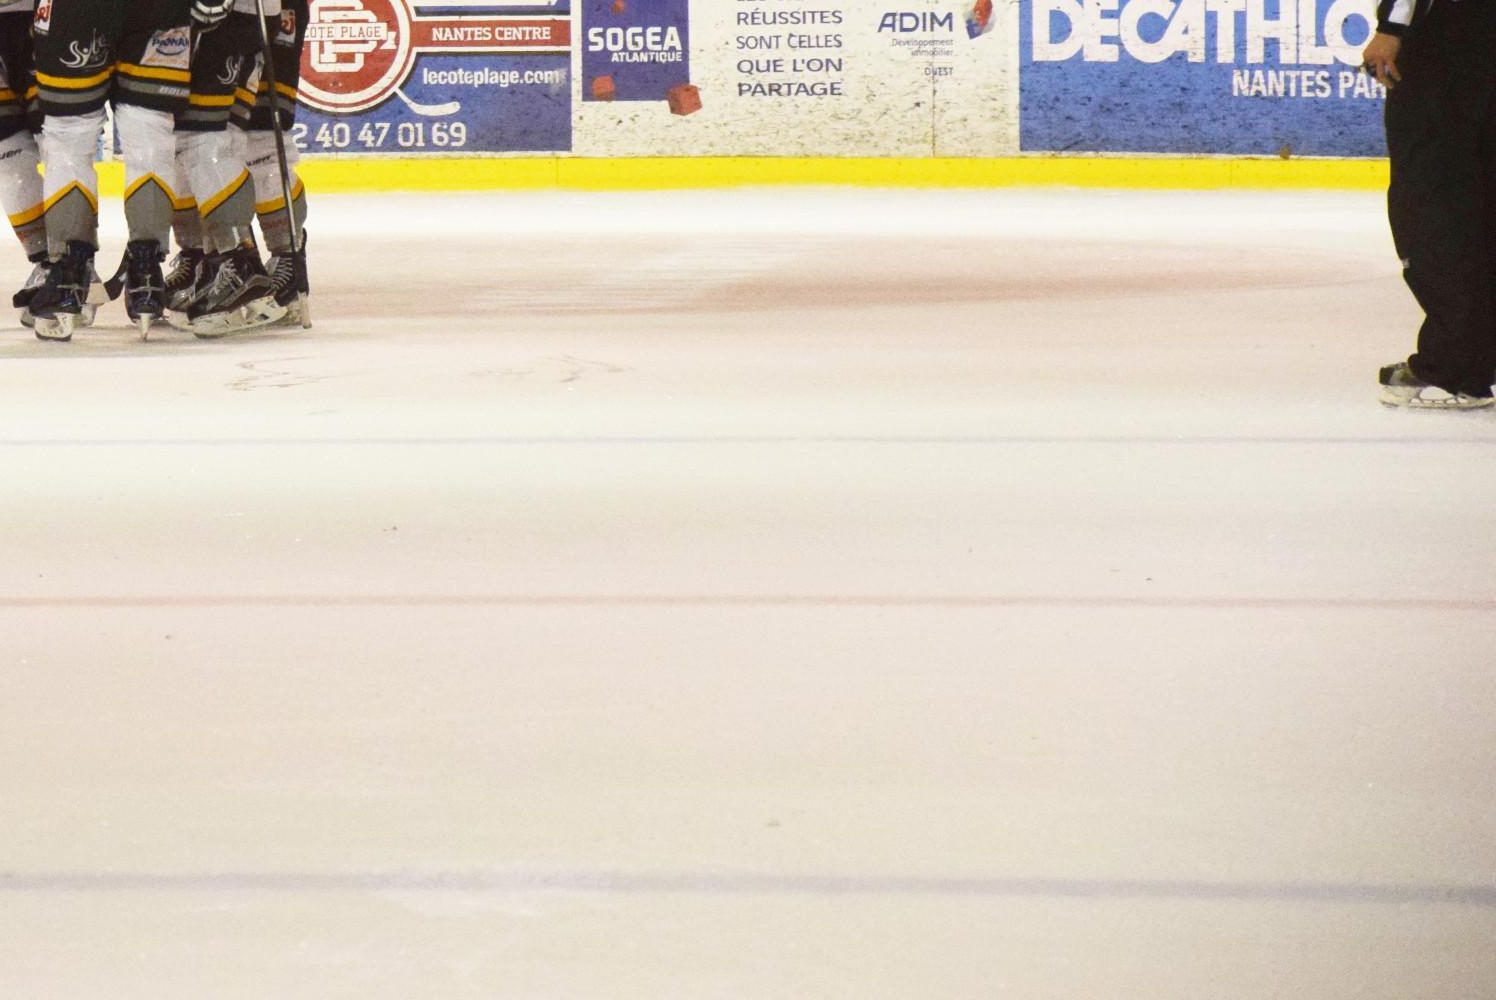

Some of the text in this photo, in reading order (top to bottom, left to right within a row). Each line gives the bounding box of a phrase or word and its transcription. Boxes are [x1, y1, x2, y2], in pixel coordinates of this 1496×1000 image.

[735, 7, 843, 26] RÉUSSITES
[877, 11, 954, 33] ADIM
[340, 25, 382, 38] PLAGE
[431, 26, 552, 42] NANTES CENTRE
[587, 26, 683, 52] SOGEA
[735, 33, 843, 50] SONT CELLES
[610, 51, 683, 64] ATLANTIQUE
[736, 57, 843, 75] QUE L'ON
[422, 66, 561, 88] lecoteplage.com
[1232, 68, 1332, 99] NANTES
[737, 81, 843, 97] PARTAGE
[315, 122, 351, 148] 40
[357, 122, 392, 148] 47
[397, 122, 425, 147] 01
[430, 121, 467, 147] 69
